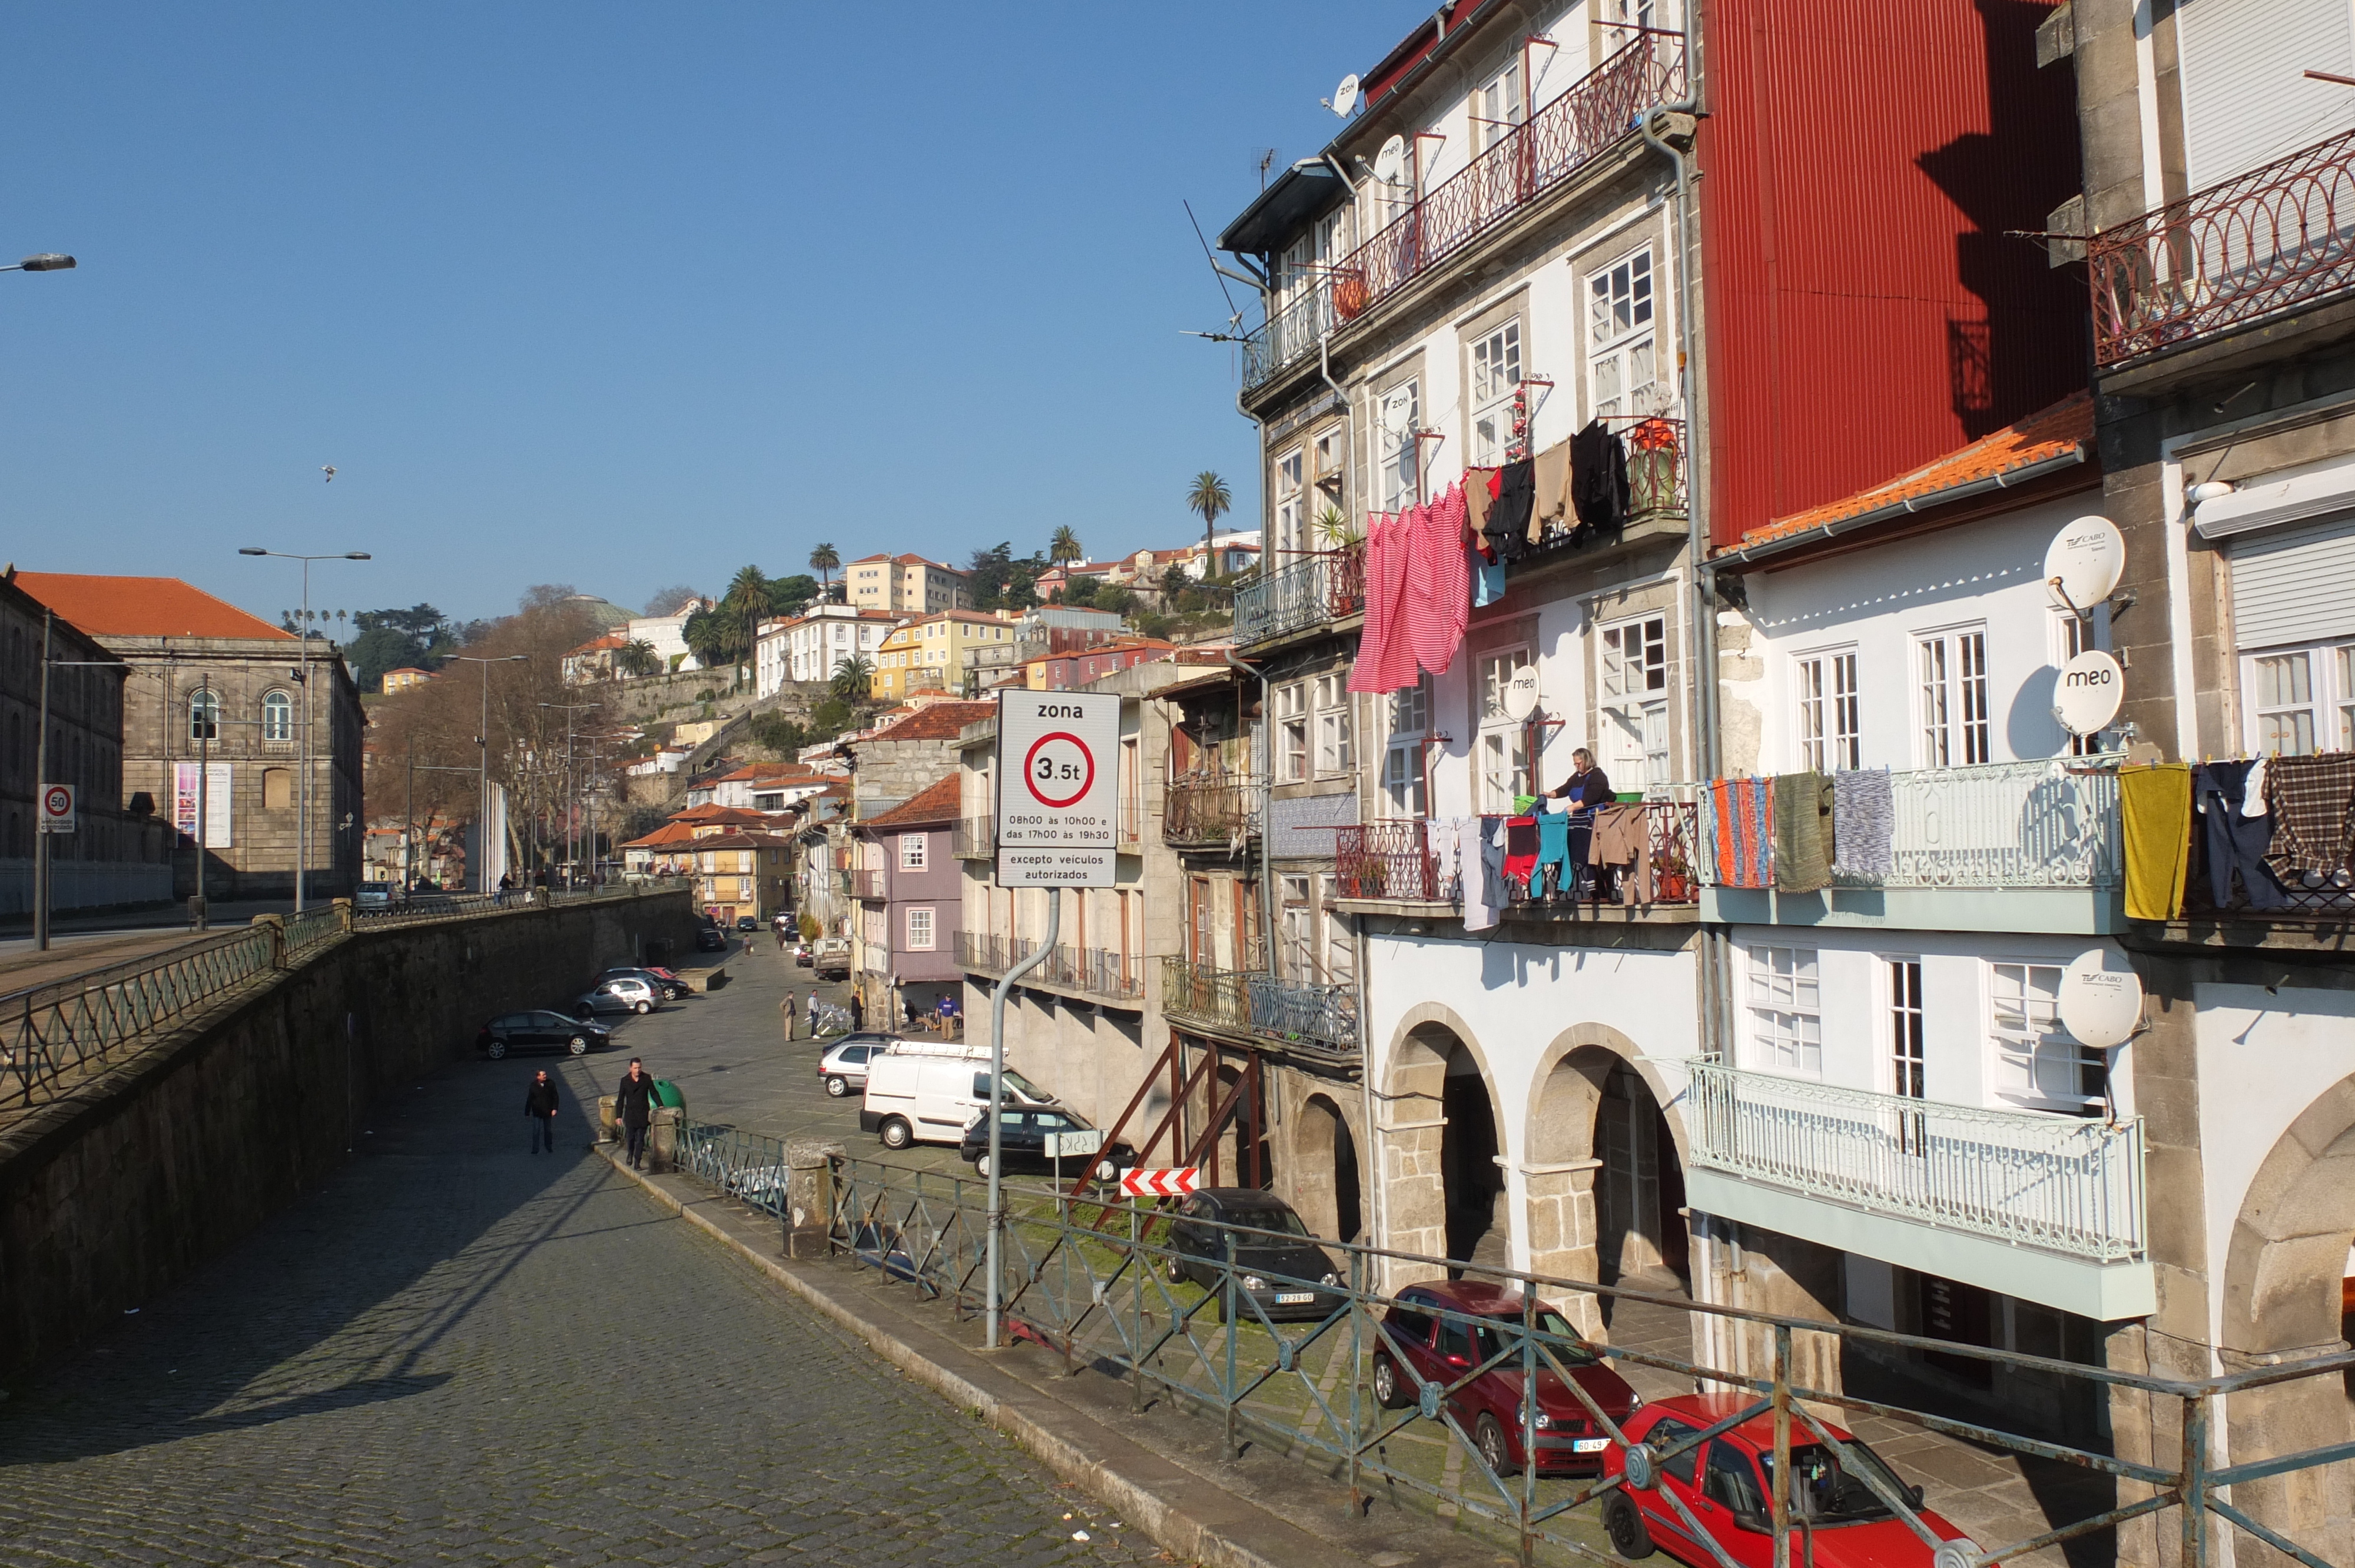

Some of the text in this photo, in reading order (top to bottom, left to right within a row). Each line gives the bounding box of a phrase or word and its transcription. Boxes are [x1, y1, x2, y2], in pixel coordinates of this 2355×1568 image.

[1340, 82, 1355, 96] ZON
[1381, 142, 1399, 160] meo
[1392, 395, 1408, 408] ZON
[2082, 532, 2105, 543] CABO
[1513, 678, 1534, 689] meo
[2067, 669, 2111, 687] meo
[1037, 705, 1083, 719] zona
[51, 797, 64, 807] 50
[1009, 815, 1043, 825] 08h00
[1048, 816, 1059, 825] às
[1064, 816, 1096, 826] 10h00
[1006, 830, 1109, 840] das 17h00 às 19h30
[1010, 854, 1103, 866] excepto veículos
[1025, 869, 1088, 880] autorizados
[2098, 975, 2122, 983] CABO
